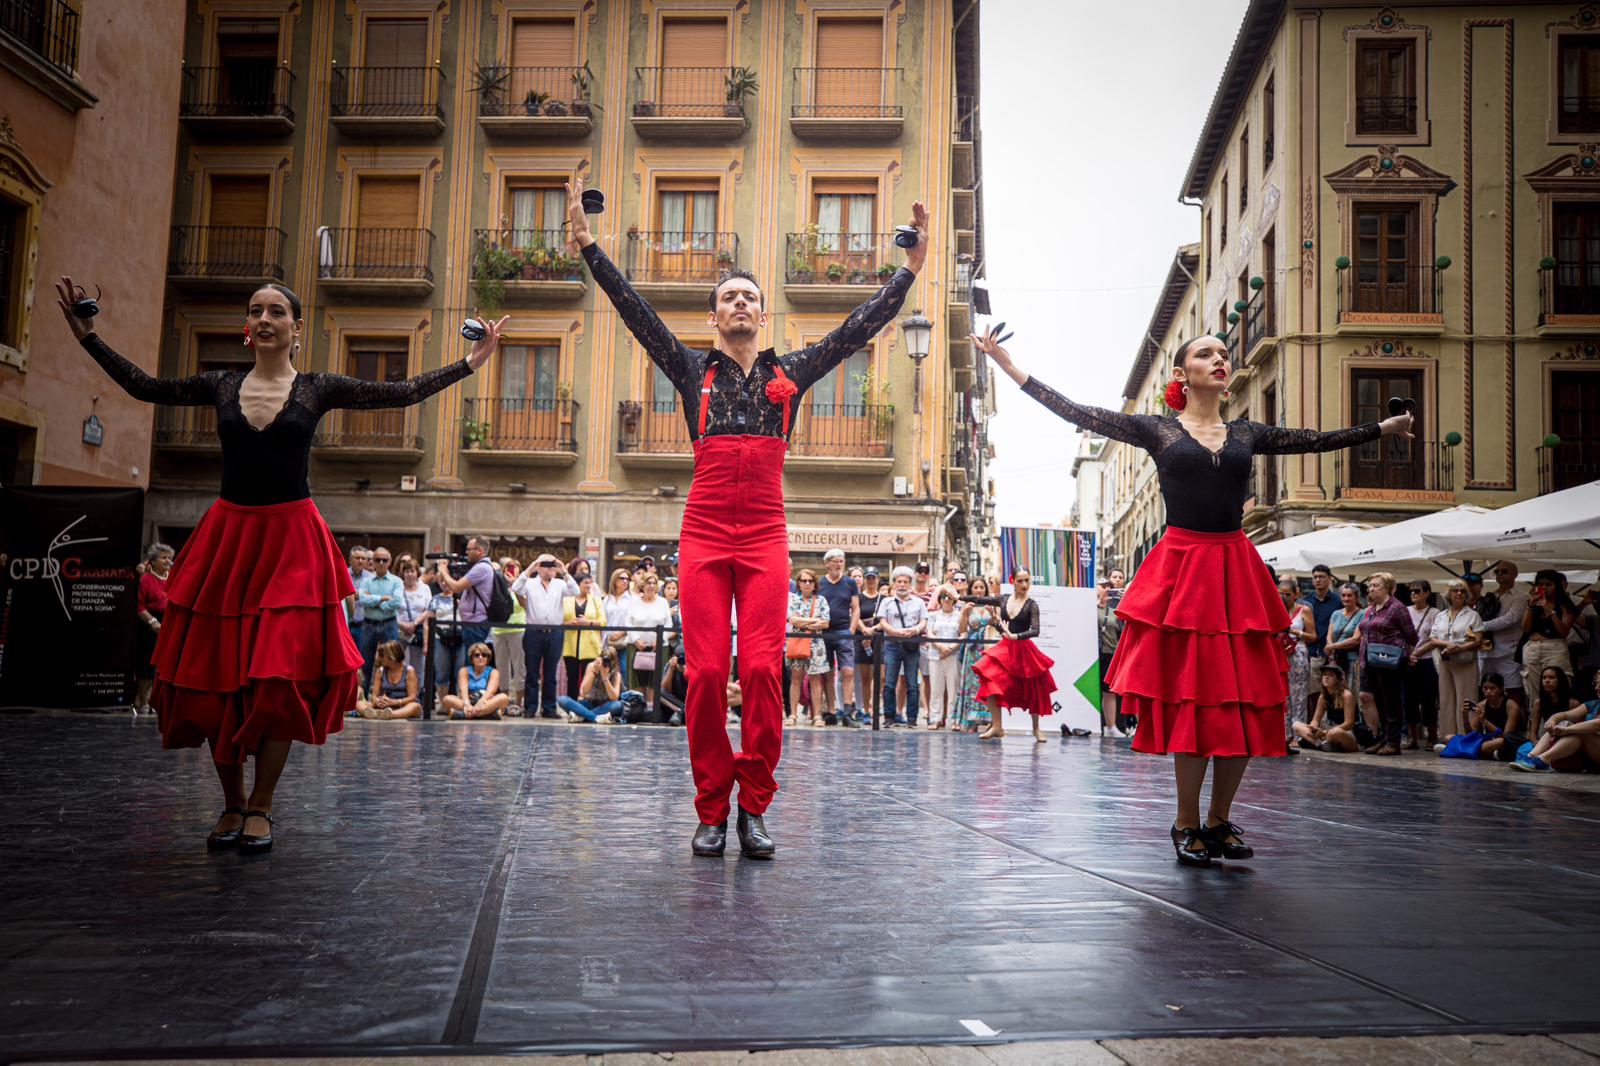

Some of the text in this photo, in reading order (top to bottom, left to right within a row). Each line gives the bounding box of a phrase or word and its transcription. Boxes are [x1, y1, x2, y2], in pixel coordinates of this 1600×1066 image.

[1353, 314, 1441, 323] CASA CATEDRAL
[1355, 491, 1449, 501] CASA CATEDRAL
[852, 534, 879, 546] RUIZ
[72, 584, 125, 592] CONSERVATORIO
